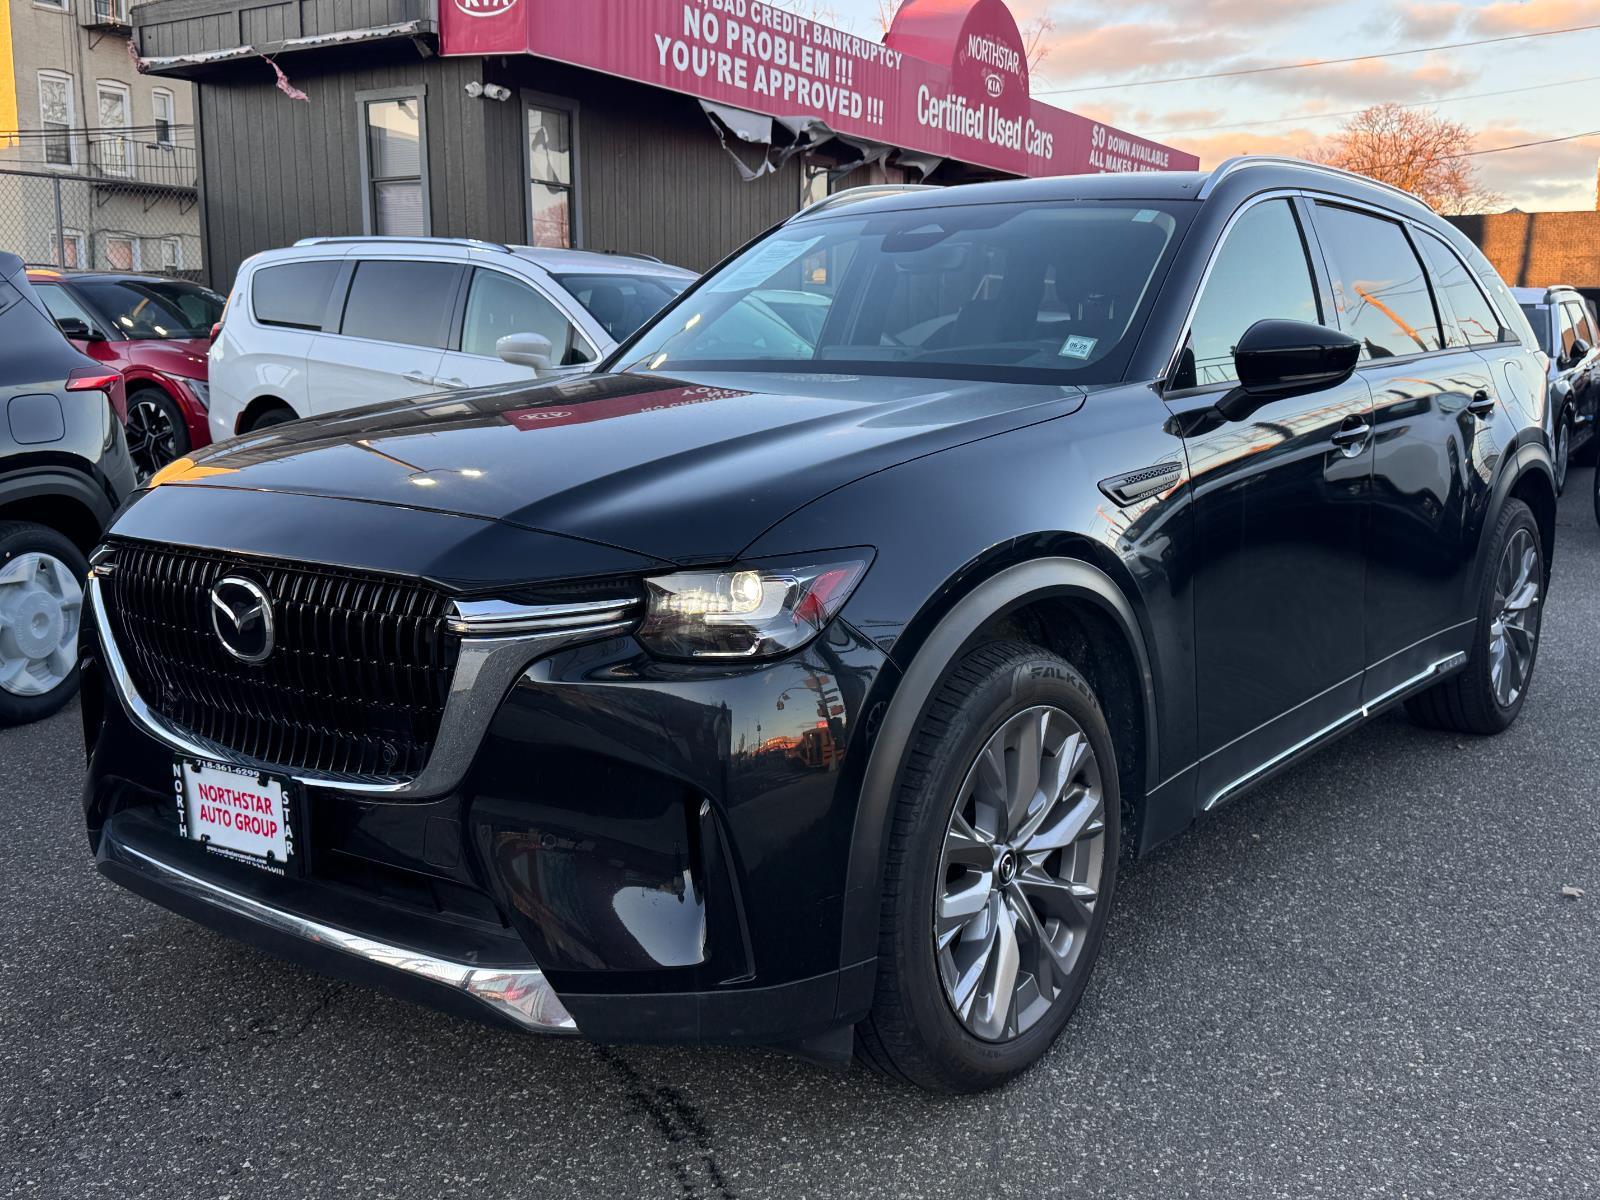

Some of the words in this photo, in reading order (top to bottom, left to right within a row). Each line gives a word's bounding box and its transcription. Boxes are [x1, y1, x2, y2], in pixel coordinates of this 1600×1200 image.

[684, 5, 719, 44] NO
[727, 19, 830, 80] PROBLEM
[836, 56, 853, 86] !!!
[751, 2, 810, 44] CREDIT,
[813, 23, 903, 70] BANKRUPTCY
[968, 33, 1020, 75] NORTHSTAR
[655, 33, 748, 89] YOU'RE
[754, 65, 863, 119] APPROVED
[867, 96, 884, 126] !!!
[986, 77, 1001, 95] KIA
[918, 84, 984, 140] Certified
[988, 106, 1022, 150] Used
[1025, 118, 1054, 160] Cars
[1089, 149, 1104, 168] ALL
[1105, 154, 1132, 173] MAKES
[1108, 135, 1131, 156] DOWN
[1131, 143, 1169, 168] AVAILABLE
[172, 763, 188, 838] NORTH
[198, 782, 274, 817] NORTHSTAR
[200, 804, 232, 828] AUTO
[235, 812, 278, 839] GROUP
[281, 791, 295, 856] STAR
